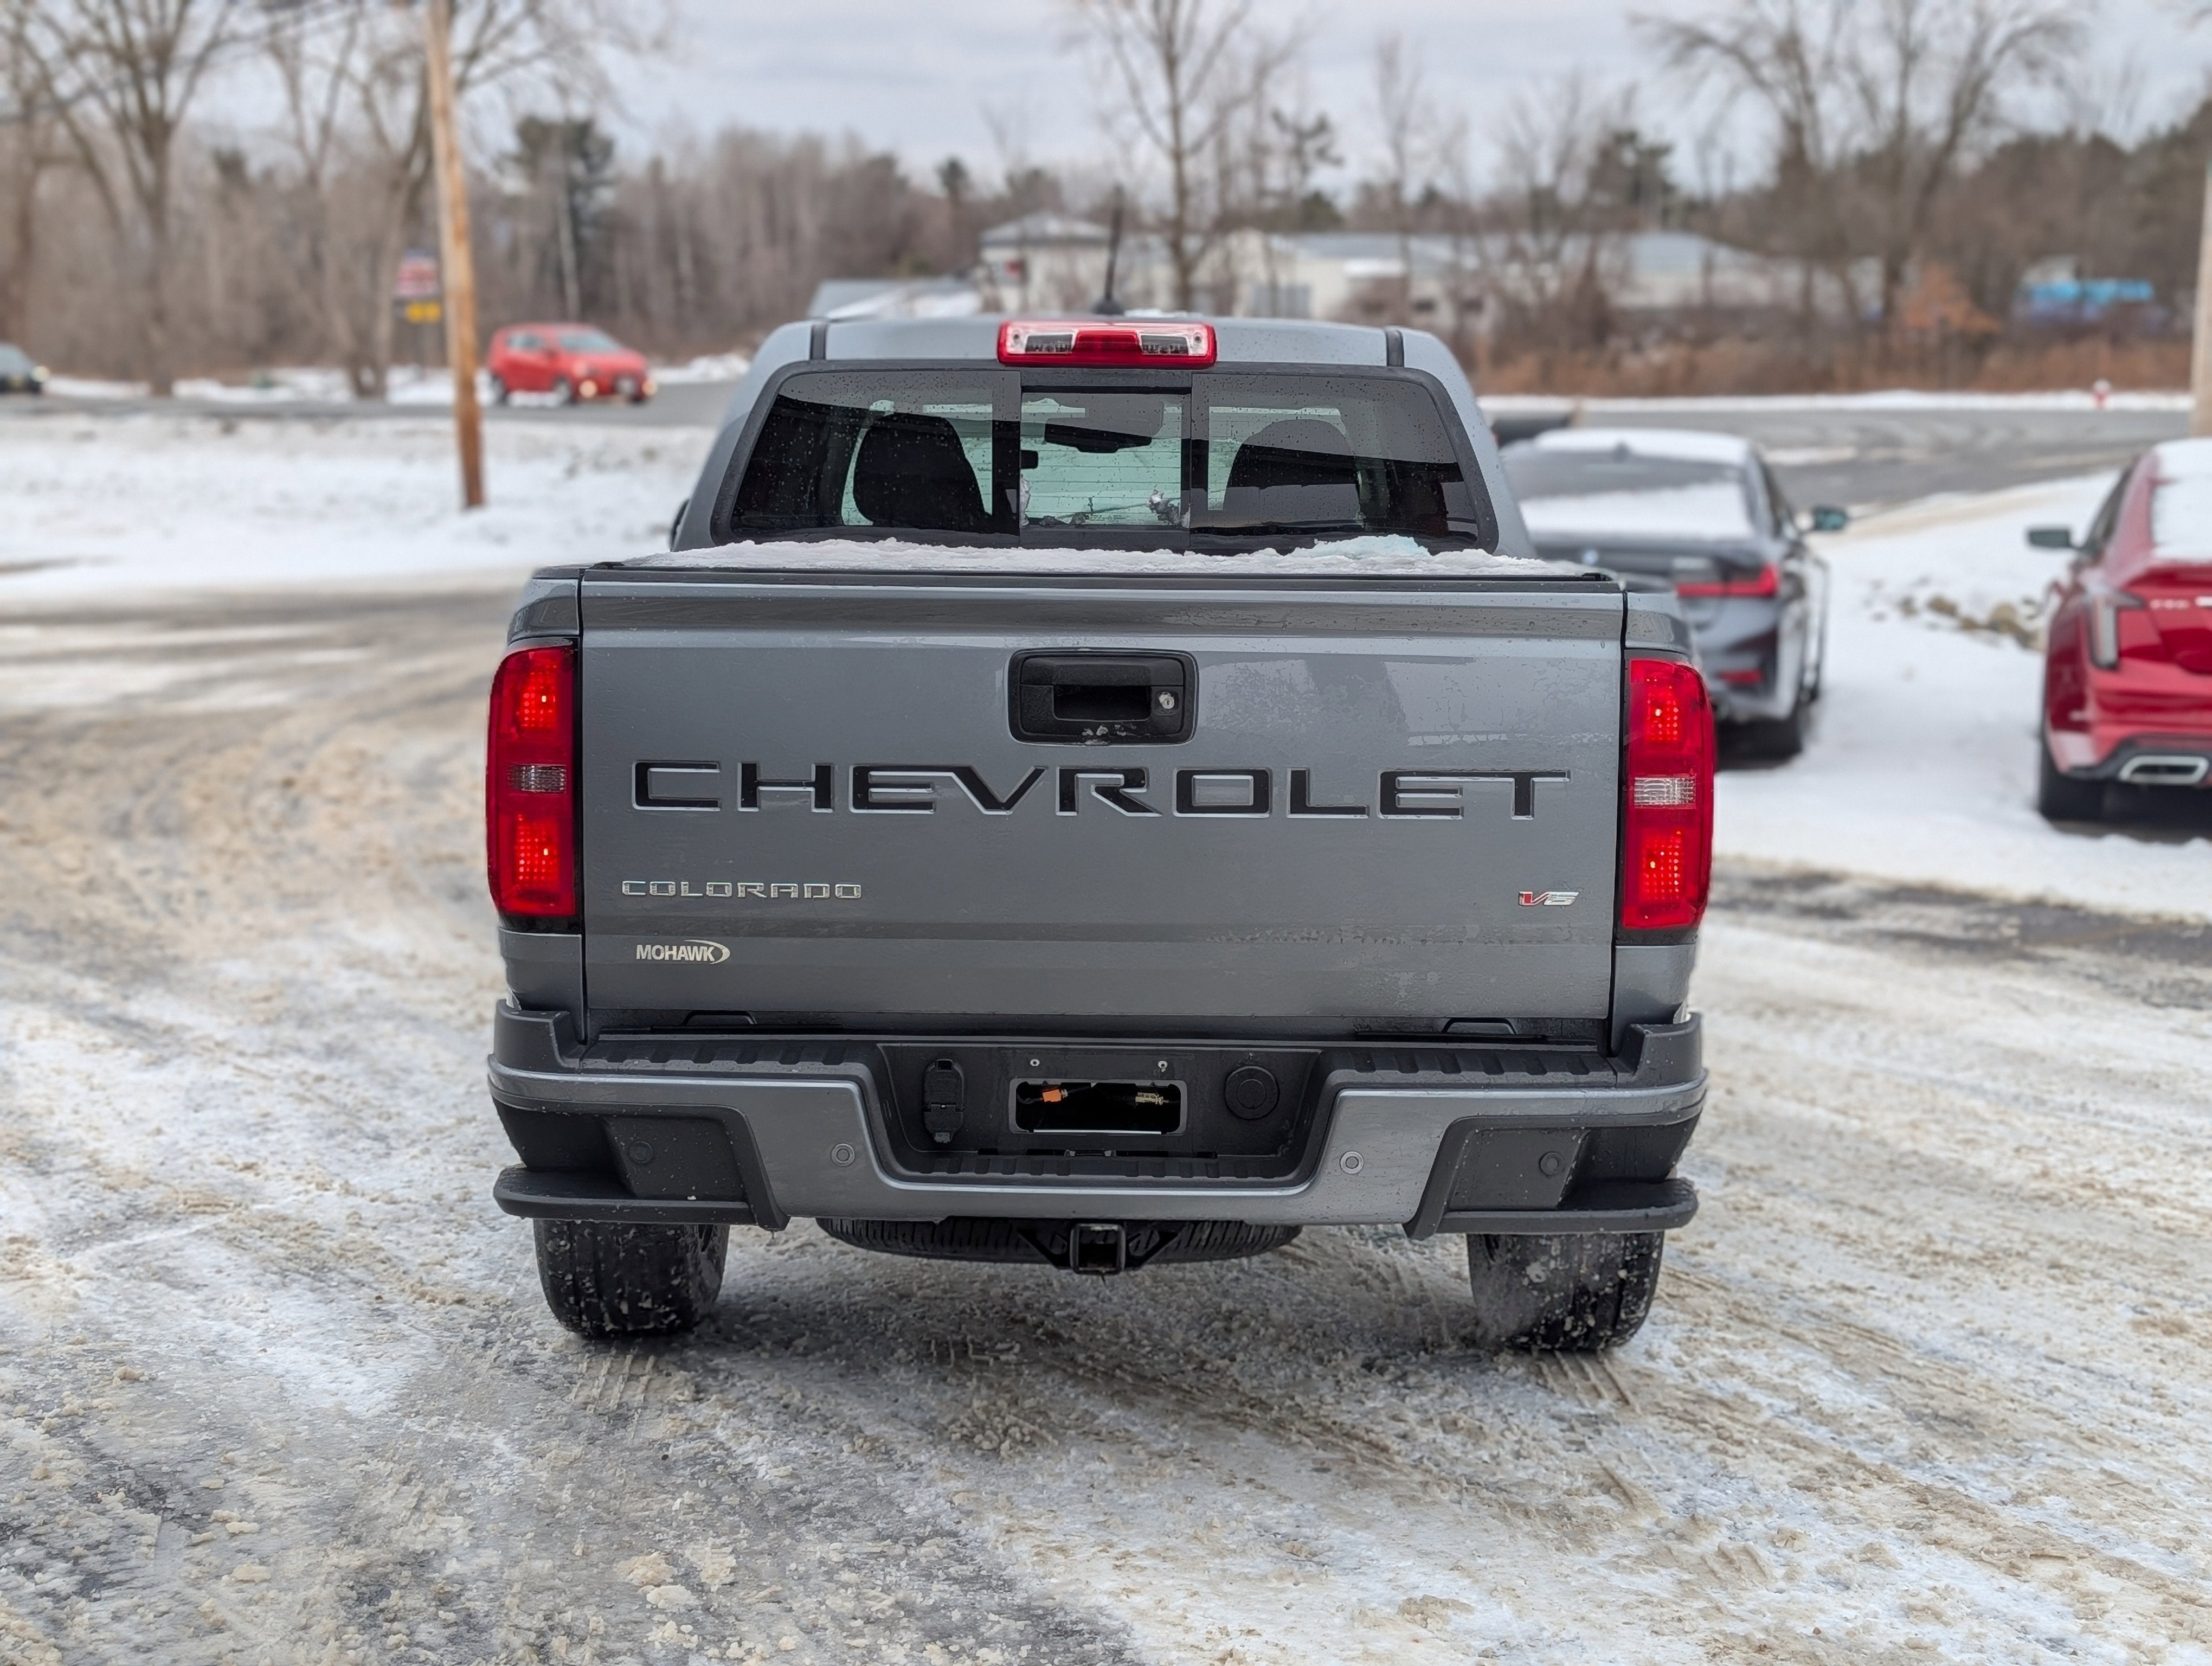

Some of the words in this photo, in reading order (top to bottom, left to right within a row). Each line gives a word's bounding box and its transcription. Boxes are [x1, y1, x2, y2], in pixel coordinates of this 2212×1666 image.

[632, 760, 1570, 820] CHEVROLET
[622, 880, 862, 899] COLORADO
[636, 944, 716, 963] MOHAWK
